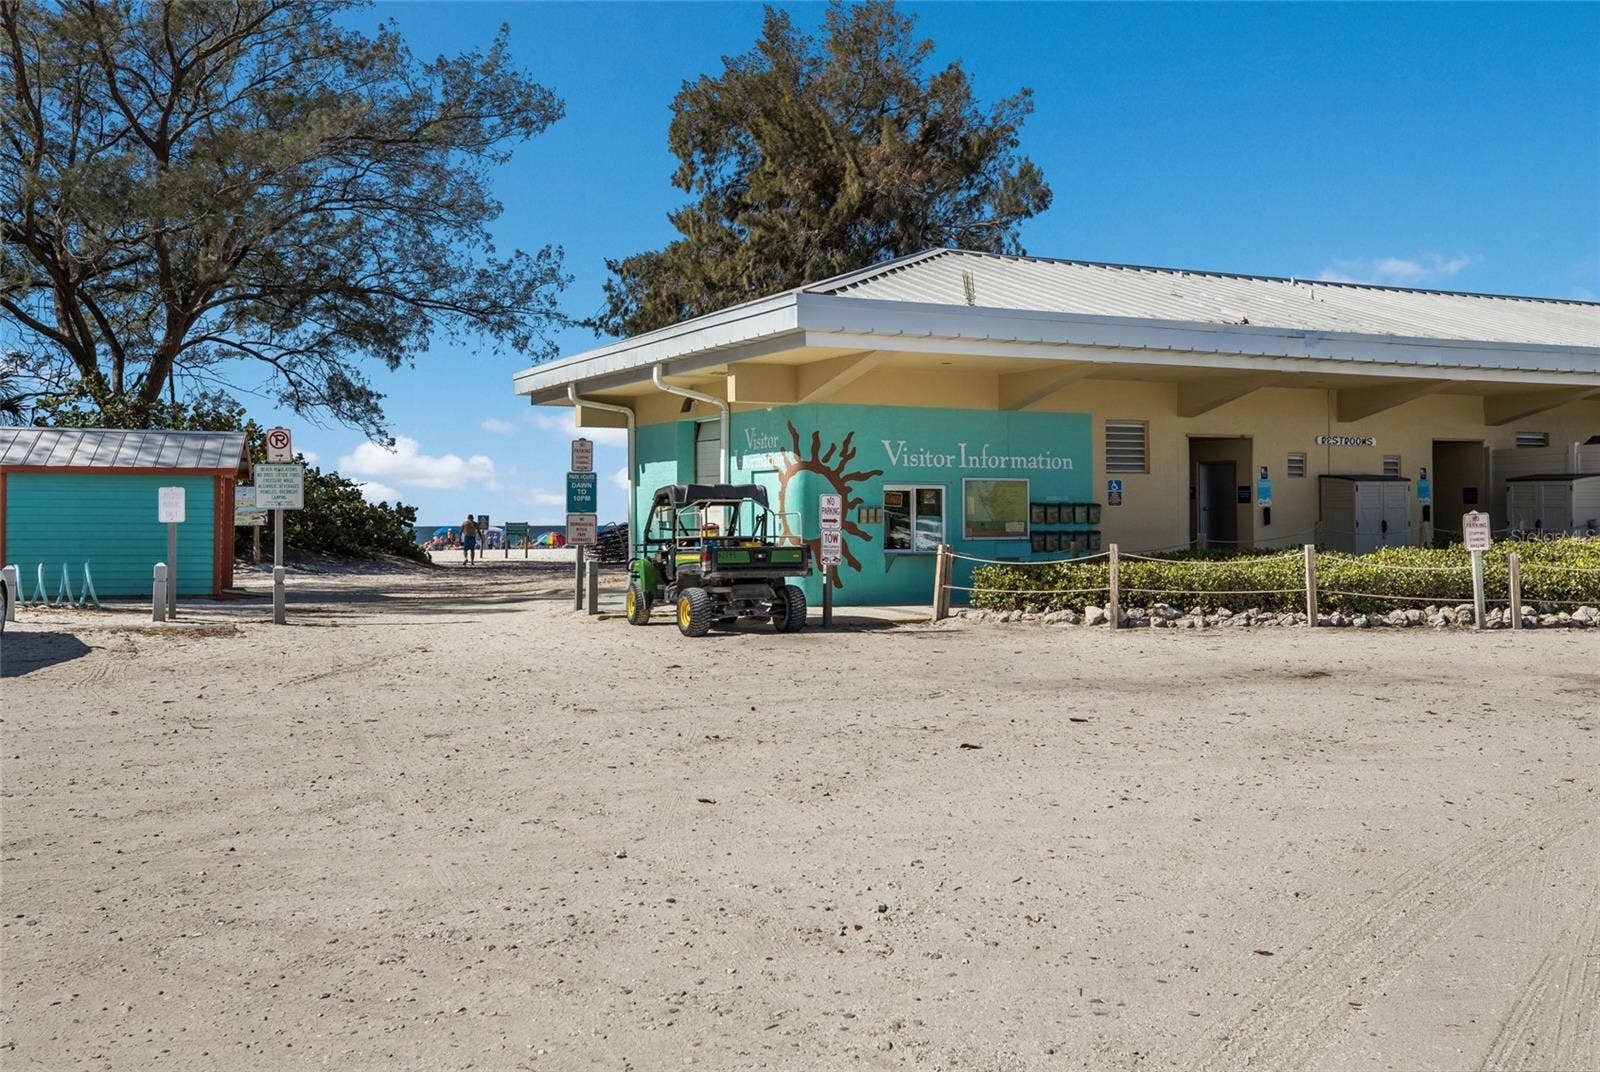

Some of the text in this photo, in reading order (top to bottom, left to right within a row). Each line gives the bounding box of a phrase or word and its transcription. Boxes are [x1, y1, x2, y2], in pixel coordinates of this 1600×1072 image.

[745, 427, 778, 450] Visitor
[1321, 436, 1373, 446] RESTROOMS
[881, 439, 1073, 470] Visitor Information
[827, 497, 835, 506] NO
[821, 507, 840, 515] PARKING
[824, 533, 839, 544] TOW
